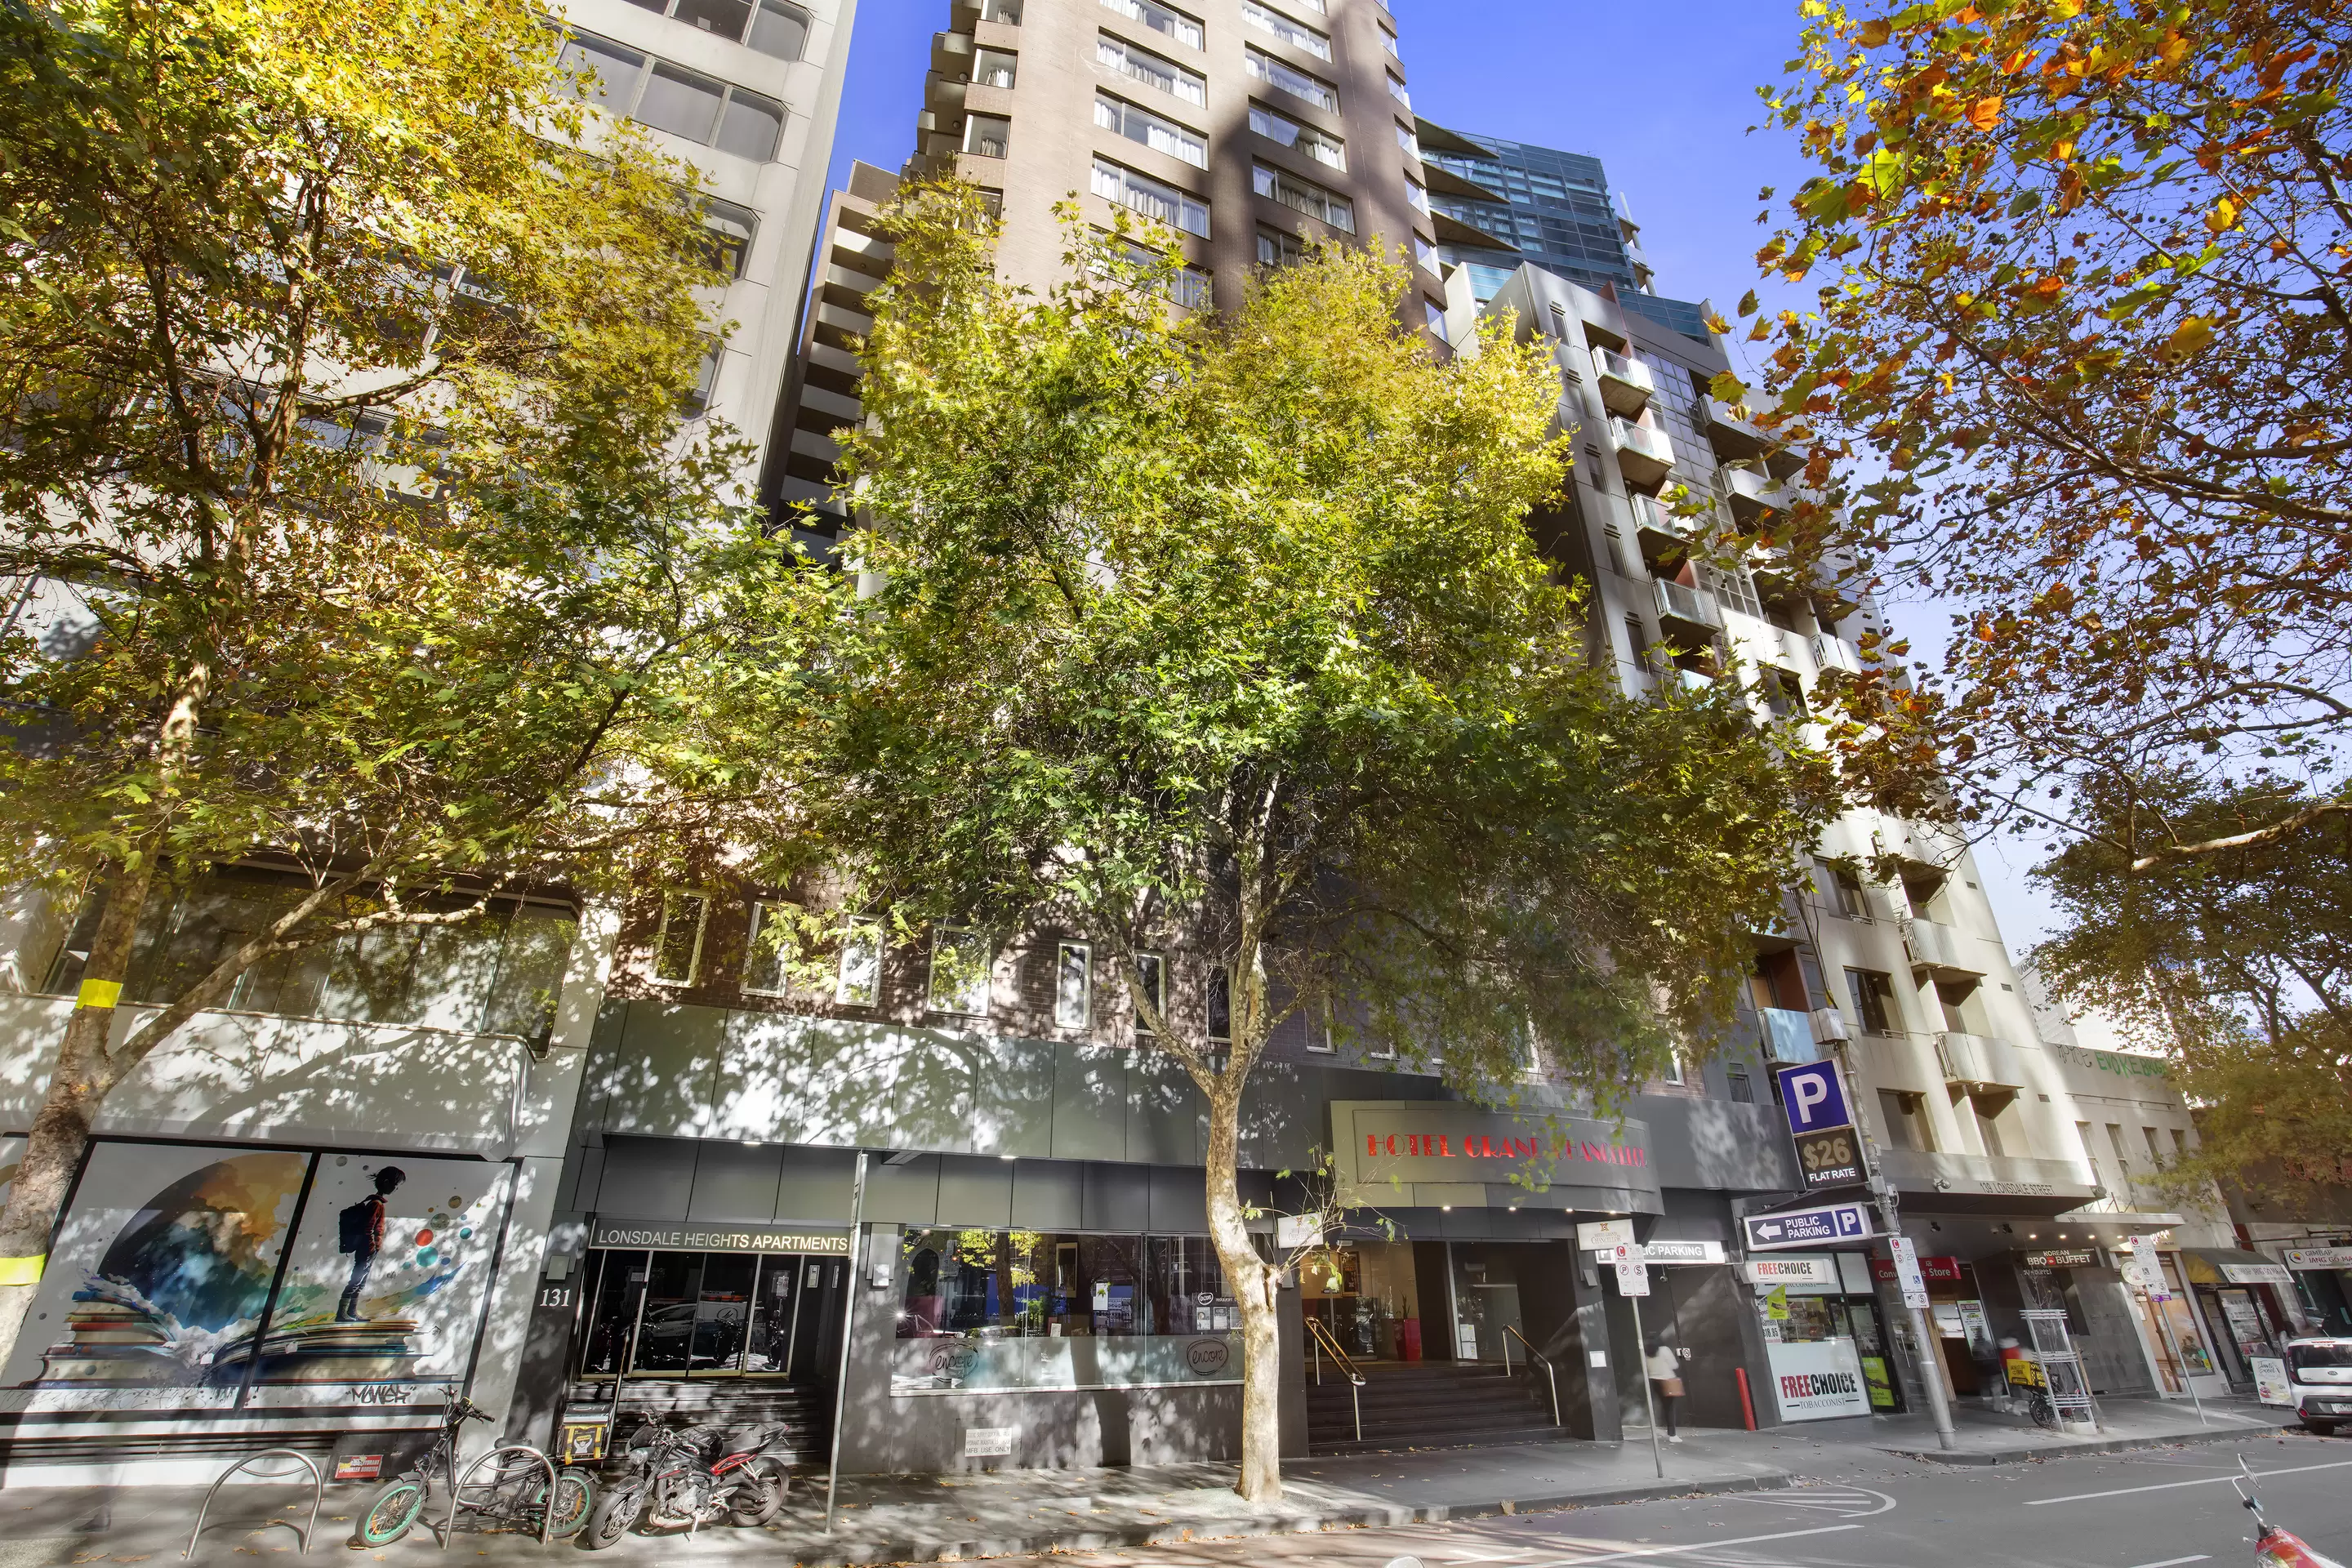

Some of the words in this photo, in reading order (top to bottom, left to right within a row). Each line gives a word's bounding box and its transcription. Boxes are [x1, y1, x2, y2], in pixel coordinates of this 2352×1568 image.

[1791, 1072, 1828, 1124] P
[1367, 1134, 1456, 1157] HOTEL
[1464, 1134, 1544, 1159] GRAND
[1802, 1138, 1851, 1169] $26
[1809, 1171, 1830, 1182] FLAT
[1832, 1168, 1856, 1178] RATE
[1980, 1182, 1993, 1194] 139
[1993, 1182, 2031, 1195] LONSDALE
[2029, 1183, 2056, 1196] STREET
[1785, 1216, 1820, 1229] PUBLIC
[1841, 1212, 1856, 1232] P
[1787, 1226, 1831, 1239] PARKING
[599, 1230, 681, 1245] LONSDALE
[684, 1232, 749, 1248] HEIGHTS
[751, 1235, 849, 1251] APARTMENTS
[1658, 1247, 1703, 1257] PARKING
[2027, 1257, 2047, 1266] BBQ
[2056, 1254, 2091, 1264] BUFFET
[1757, 1263, 1812, 1275] FREECHOICE
[1929, 1268, 1951, 1276] Store
[540, 1289, 571, 1307] 131
[935, 1355, 973, 1370] encore
[1193, 1349, 1223, 1365] encore
[1780, 1372, 1858, 1399] FREECHOICE
[1799, 1398, 1846, 1410] TOBACCONIST
